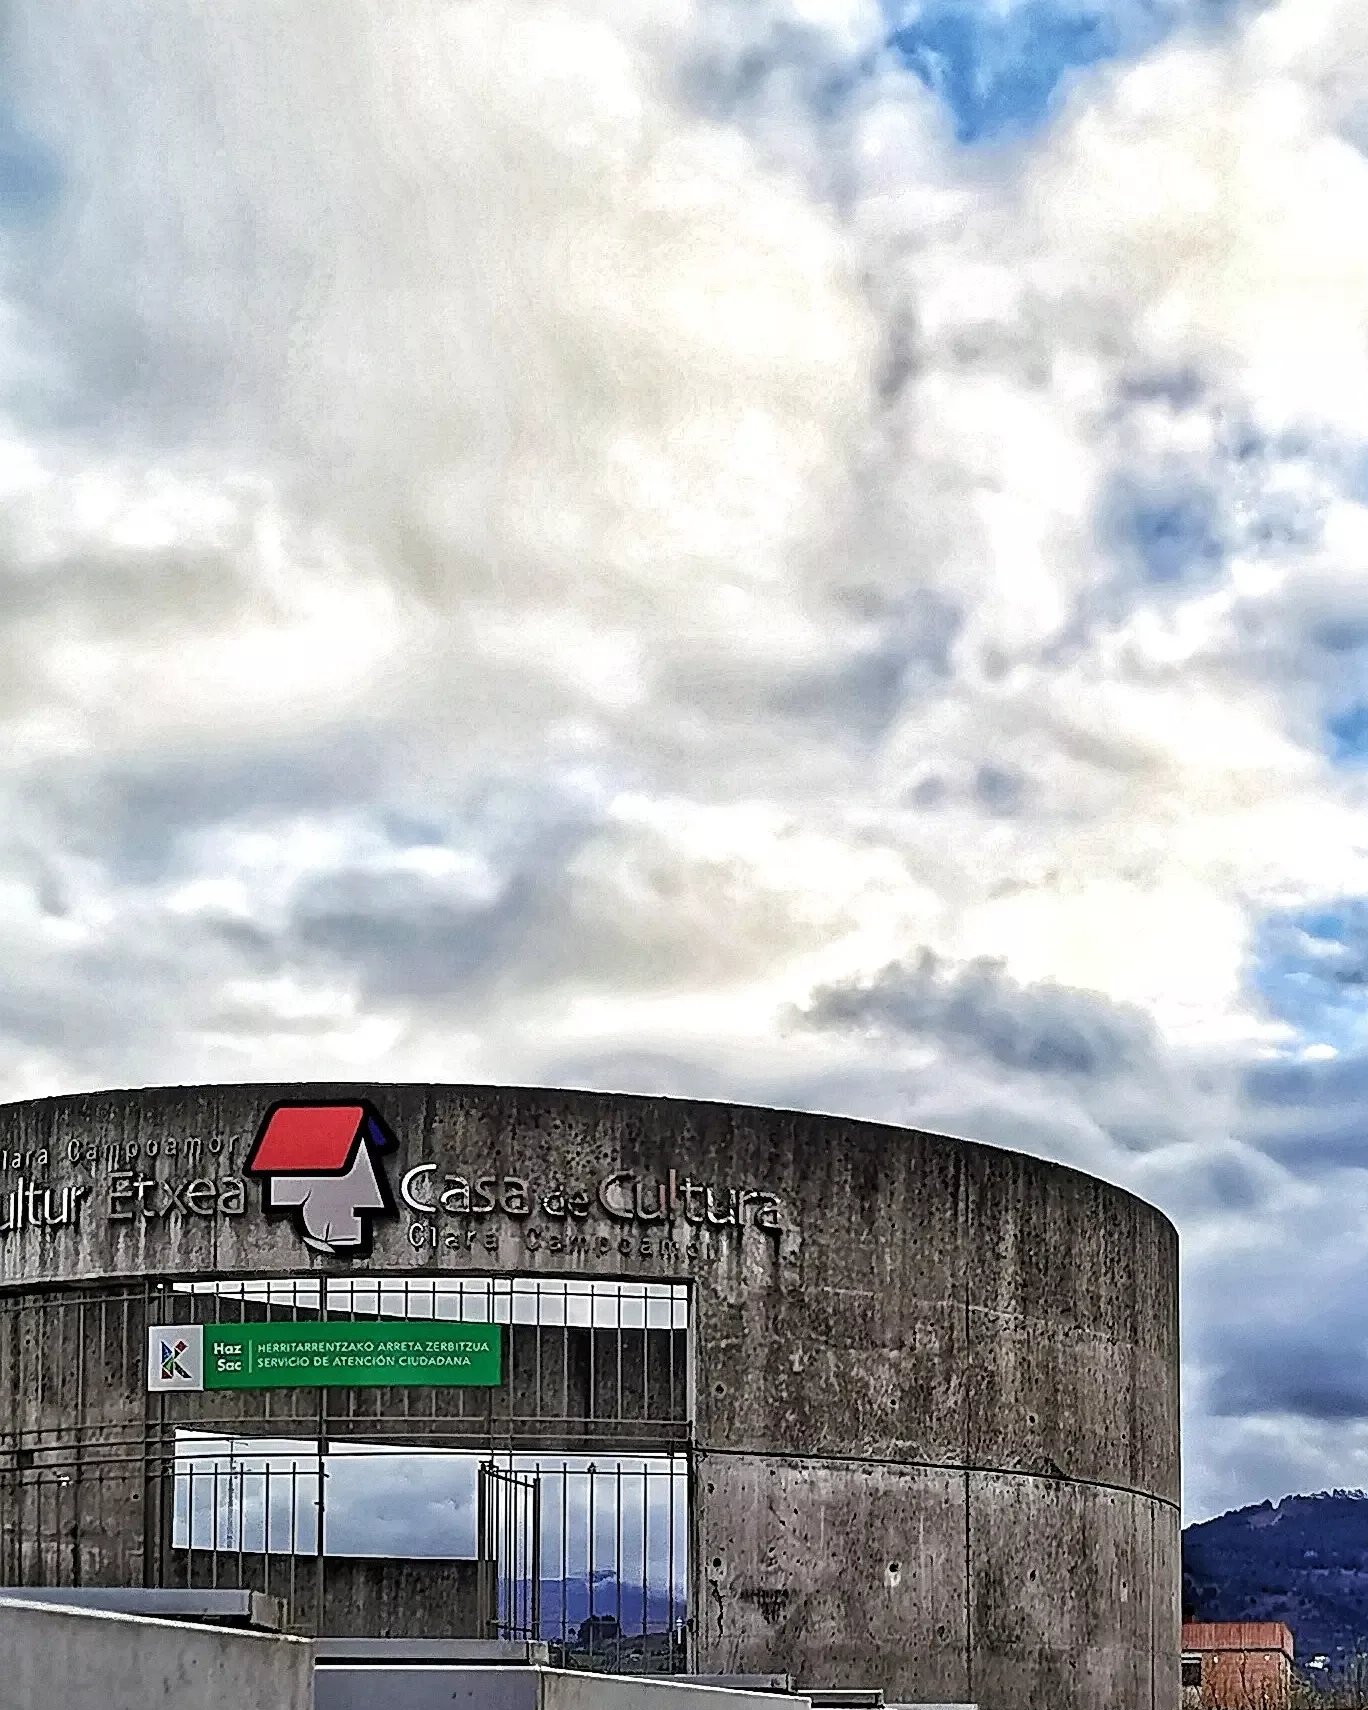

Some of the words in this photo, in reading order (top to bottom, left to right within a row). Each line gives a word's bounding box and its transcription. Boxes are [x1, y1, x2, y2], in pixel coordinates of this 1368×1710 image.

[67, 1135, 240, 1163] Campoamor
[108, 1171, 245, 1219] Etxea
[401, 1163, 530, 1214] Casa
[542, 1184, 589, 1216] de
[599, 1168, 782, 1229] Cultura
[409, 1222, 498, 1249] Clara
[213, 1342, 242, 1355] Haz
[257, 1341, 375, 1353] HERRITARRENTZAKO
[377, 1341, 423, 1352] ARRETA
[425, 1341, 490, 1352] ZERBITZUA
[217, 1358, 242, 1371] Sac
[257, 1356, 310, 1368] SERVICIO
[313, 1356, 329, 1366] DE
[332, 1354, 395, 1366] ATENCIÓN
[398, 1355, 471, 1366] CIUDADANA
